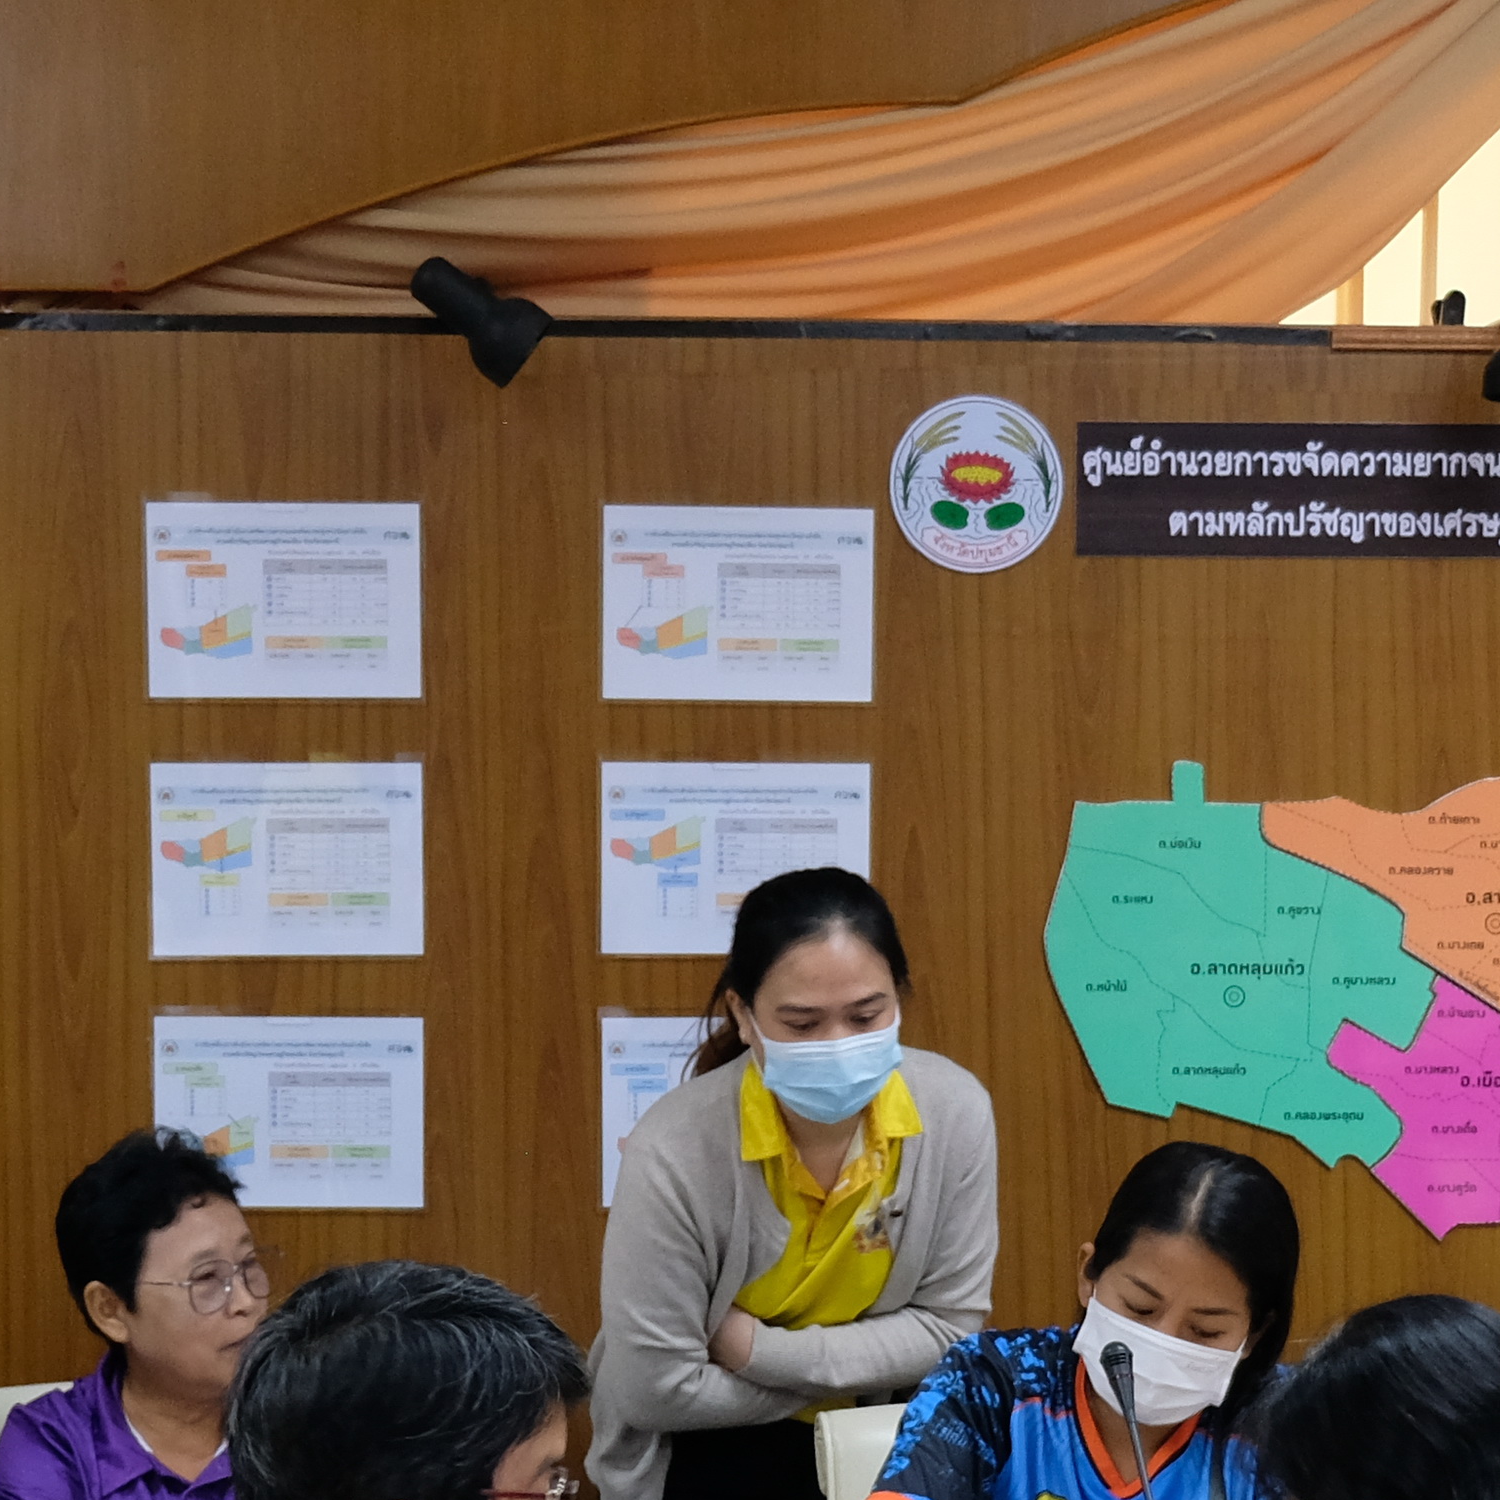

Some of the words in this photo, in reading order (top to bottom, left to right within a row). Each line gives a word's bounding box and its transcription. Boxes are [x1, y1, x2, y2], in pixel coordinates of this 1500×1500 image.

[1190, 958, 1306, 980] อ.ลาดหลุมแก้ว
